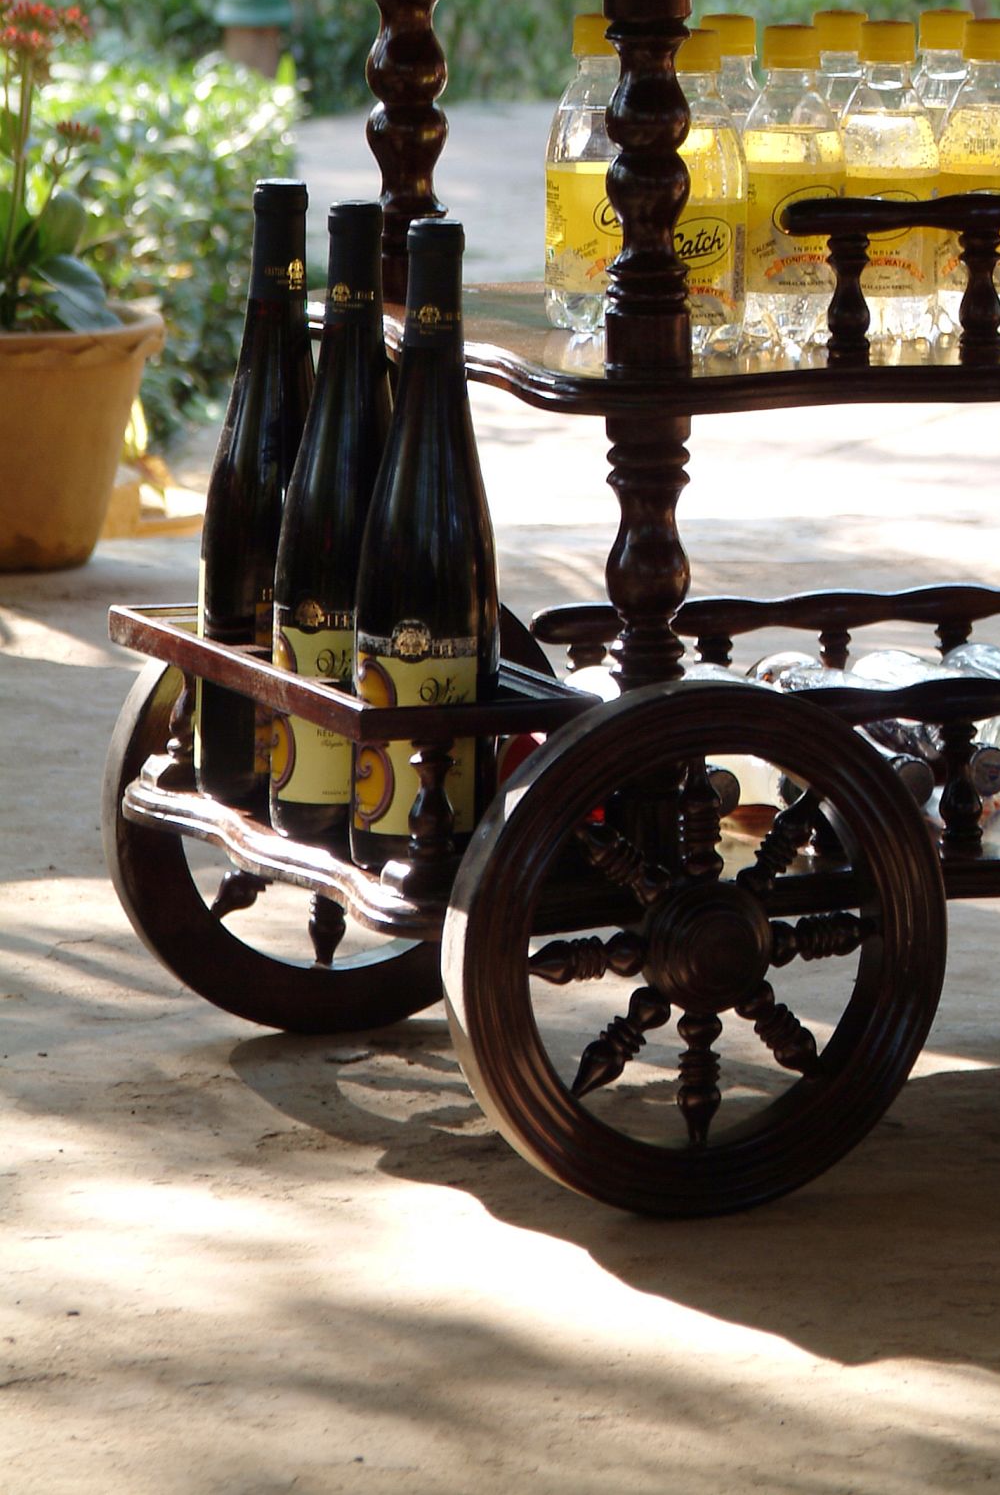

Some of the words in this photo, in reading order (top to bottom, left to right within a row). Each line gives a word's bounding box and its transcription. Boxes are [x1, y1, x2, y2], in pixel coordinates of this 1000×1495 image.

[673, 225, 725, 258] Catch
[781, 256, 808, 267] TONIC
[809, 255, 827, 263] WAT
[884, 259, 912, 270] WATER
